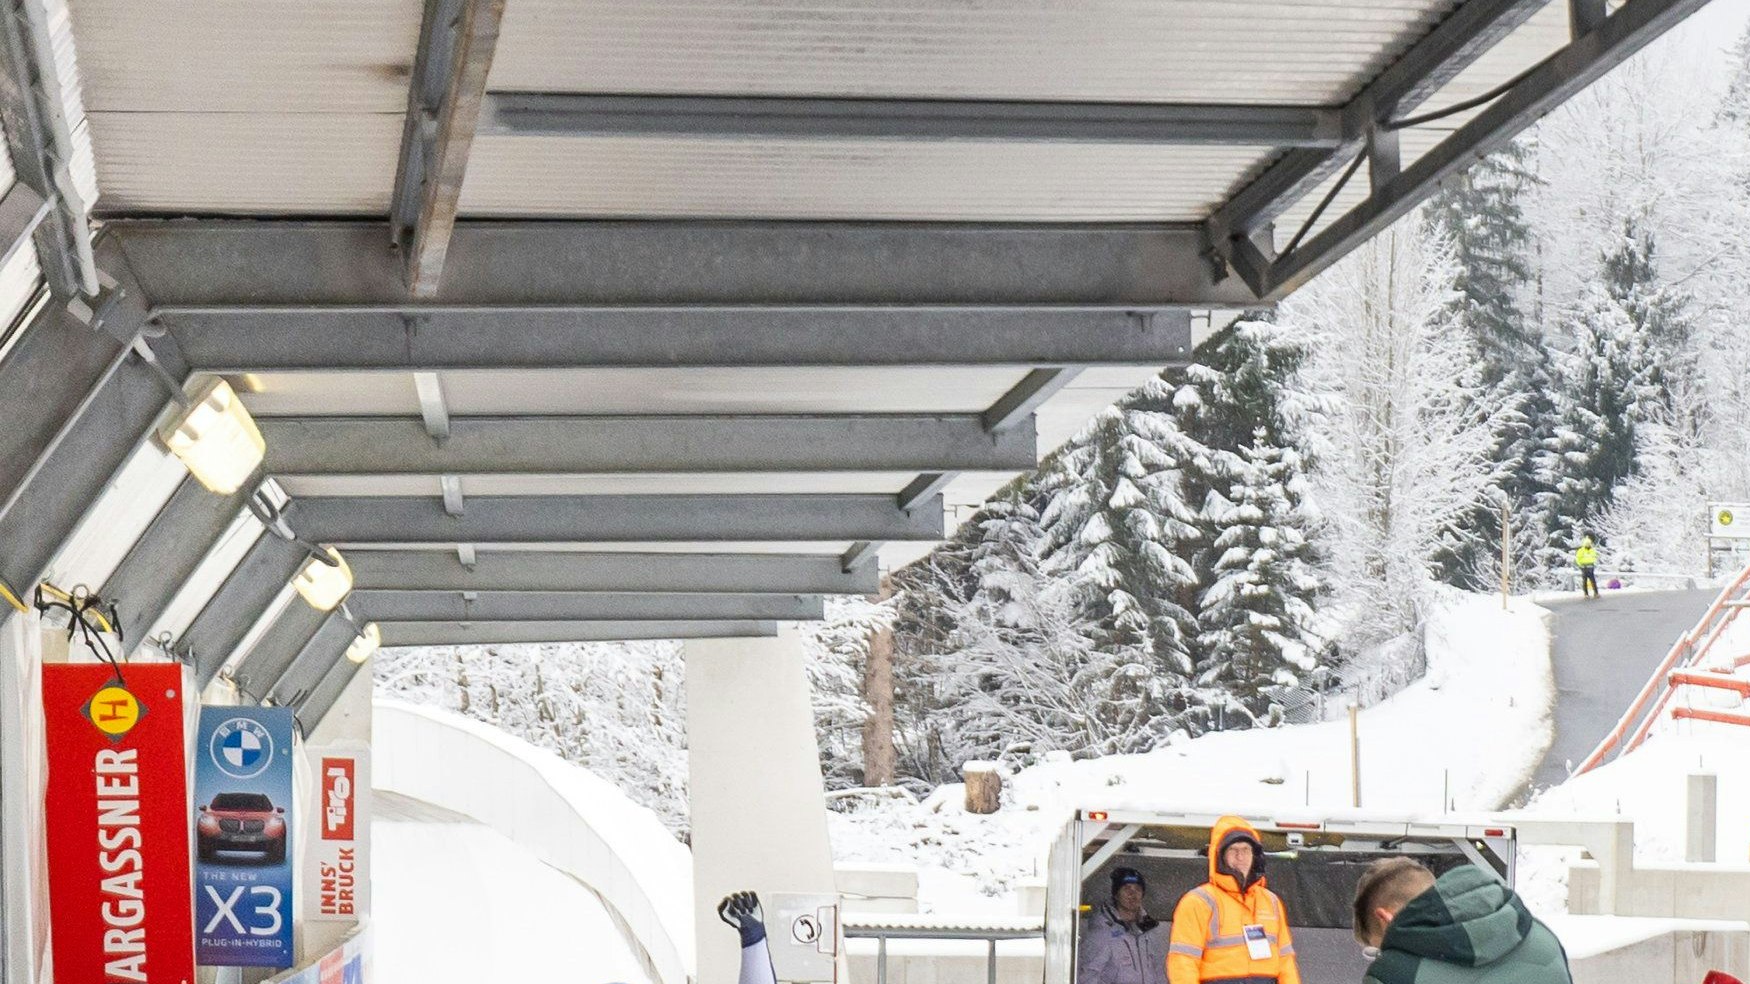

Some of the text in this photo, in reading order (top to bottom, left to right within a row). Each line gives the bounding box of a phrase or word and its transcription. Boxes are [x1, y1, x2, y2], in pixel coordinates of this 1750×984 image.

[326, 767, 350, 831] Tirol
[203, 871, 258, 880] THE NEW
[320, 861, 337, 915] INNS'
[338, 847, 355, 915] BRUCK
[203, 885, 282, 936] X3
[201, 938, 282, 948] PLUG-IN-HYBRID
